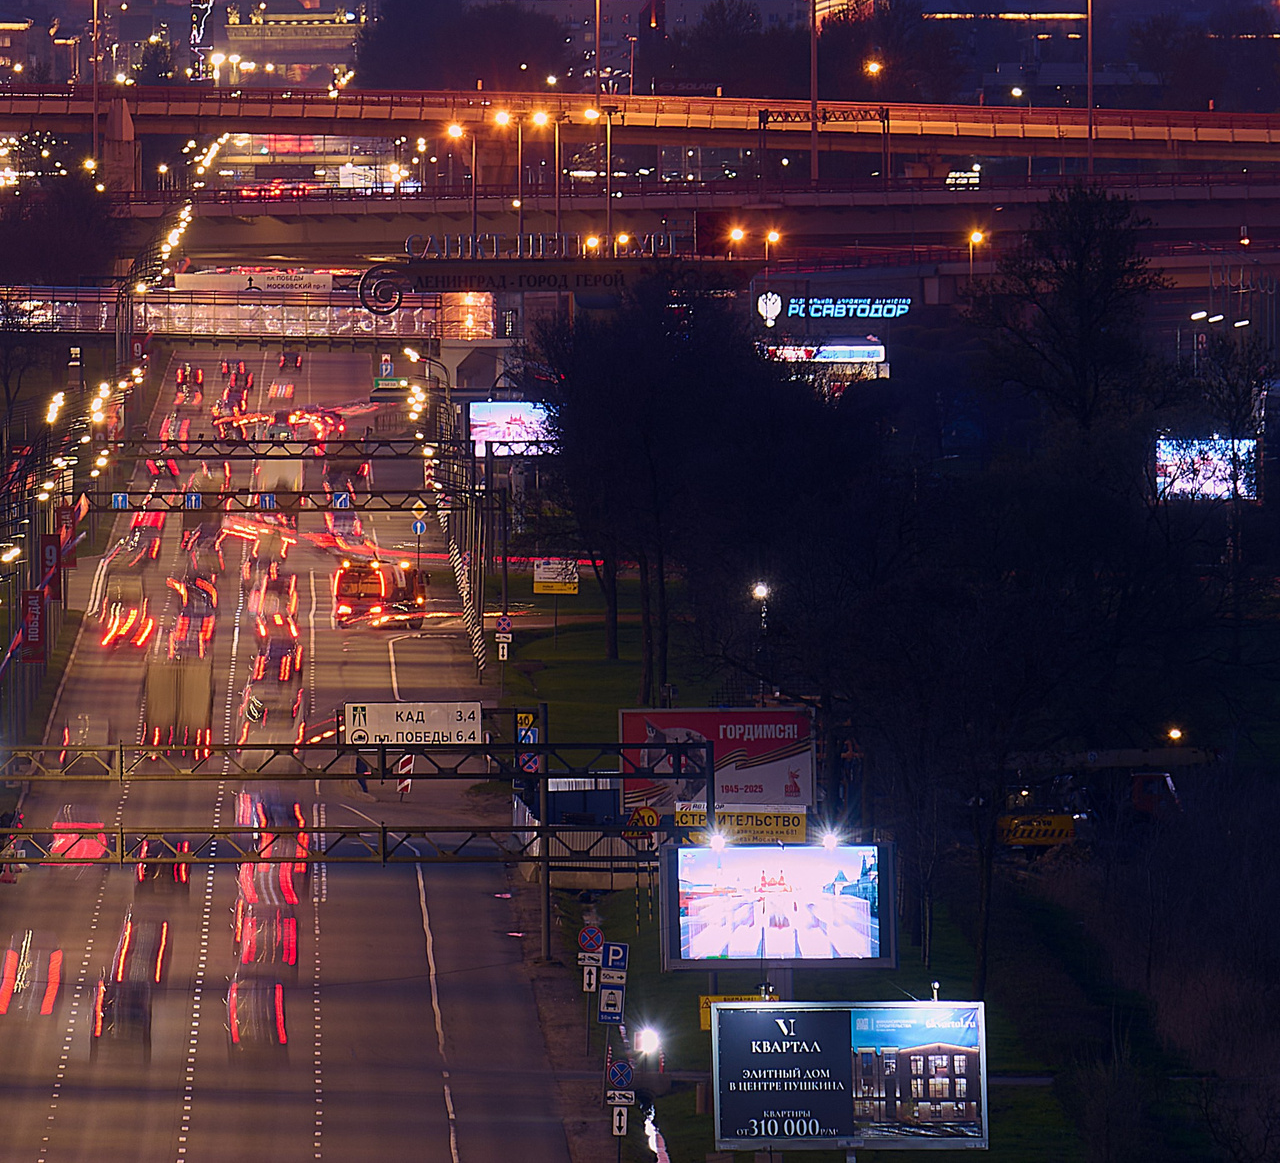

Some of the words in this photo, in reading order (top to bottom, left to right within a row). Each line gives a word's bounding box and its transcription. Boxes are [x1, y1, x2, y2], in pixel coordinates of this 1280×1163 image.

[414, 274, 508, 290] ЛЕНИНГРАД
[519, 273, 570, 289] ГОРОД
[575, 269, 626, 288] ГЕРОЙ
[787, 303, 910, 318] РОСАВТОДОР
[45, 544, 58, 567] 9
[395, 710, 425, 724] КАД
[455, 710, 476, 723] 3,4
[374, 734, 393, 743] пл.
[396, 731, 452, 744] ПОБЕДЫ
[456, 730, 476, 743] 6,4
[719, 724, 798, 742] ГОРДИМСЯ!
[680, 813, 801, 827] СТРИТЕЛЬСТВО
[751, 1040, 822, 1053] КВАРТАЛ
[742, 1067, 801, 1079] ЭЛИТНЫЙ
[803, 1069, 830, 1079] ДОМ
[729, 1081, 737, 1091] В
[738, 1081, 782, 1092] ЦЕНТРЕ
[784, 1081, 845, 1091] ПУШКИНА
[763, 1110, 811, 1118] КВАРТИРЫ
[748, 1119, 779, 1137] 310
[783, 1119, 820, 1137] 000
